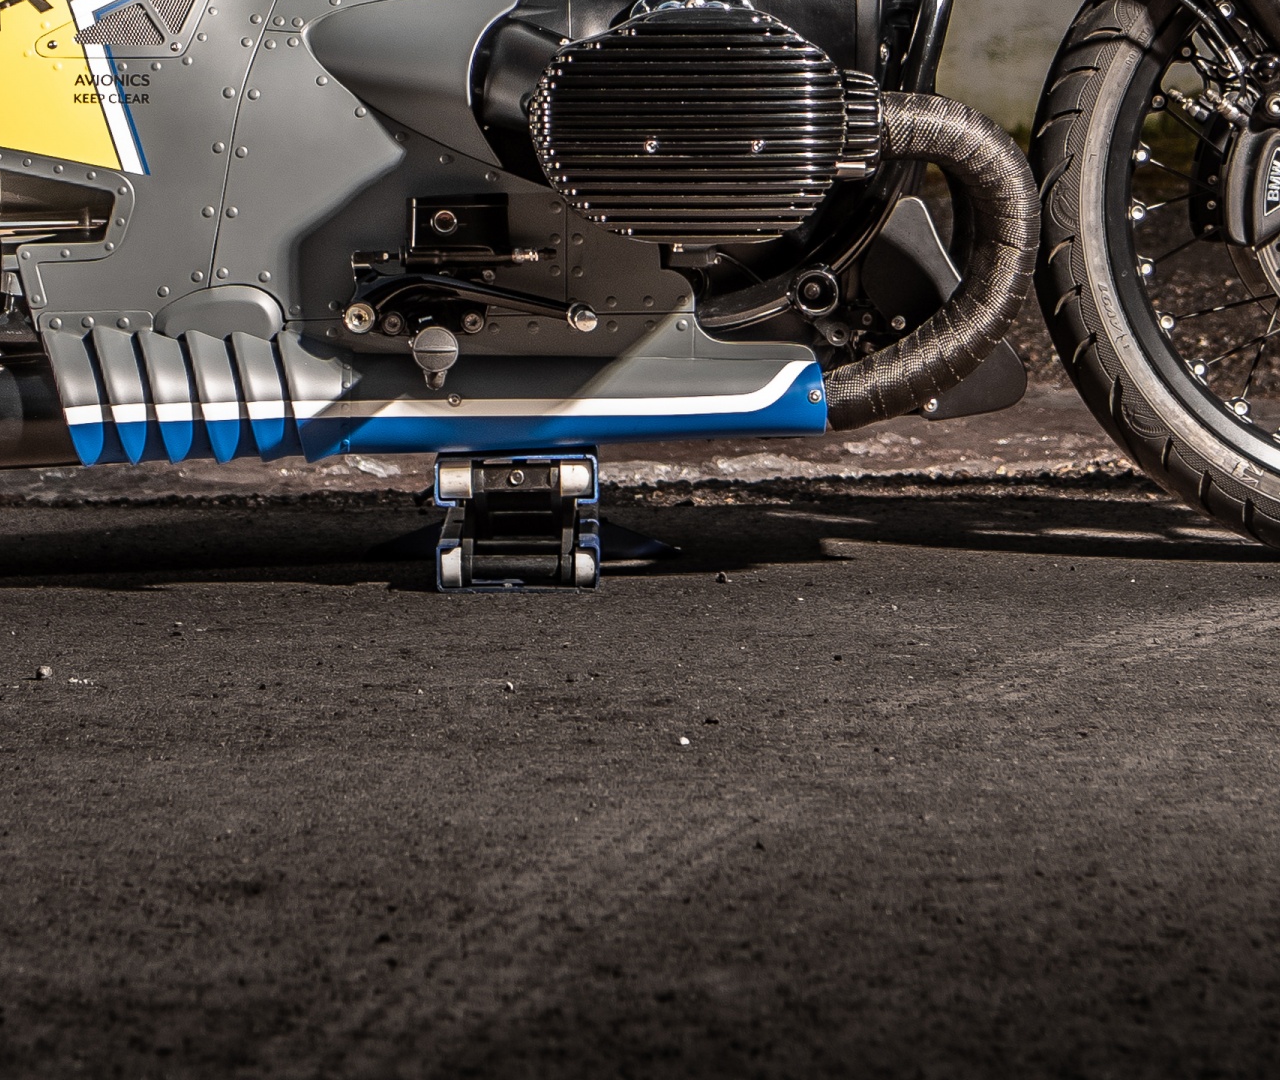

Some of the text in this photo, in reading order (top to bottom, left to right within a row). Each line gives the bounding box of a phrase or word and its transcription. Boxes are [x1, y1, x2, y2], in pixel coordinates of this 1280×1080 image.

[74, 74, 150, 87] AVIONICS
[74, 93, 150, 104] KEEP CLEAR
